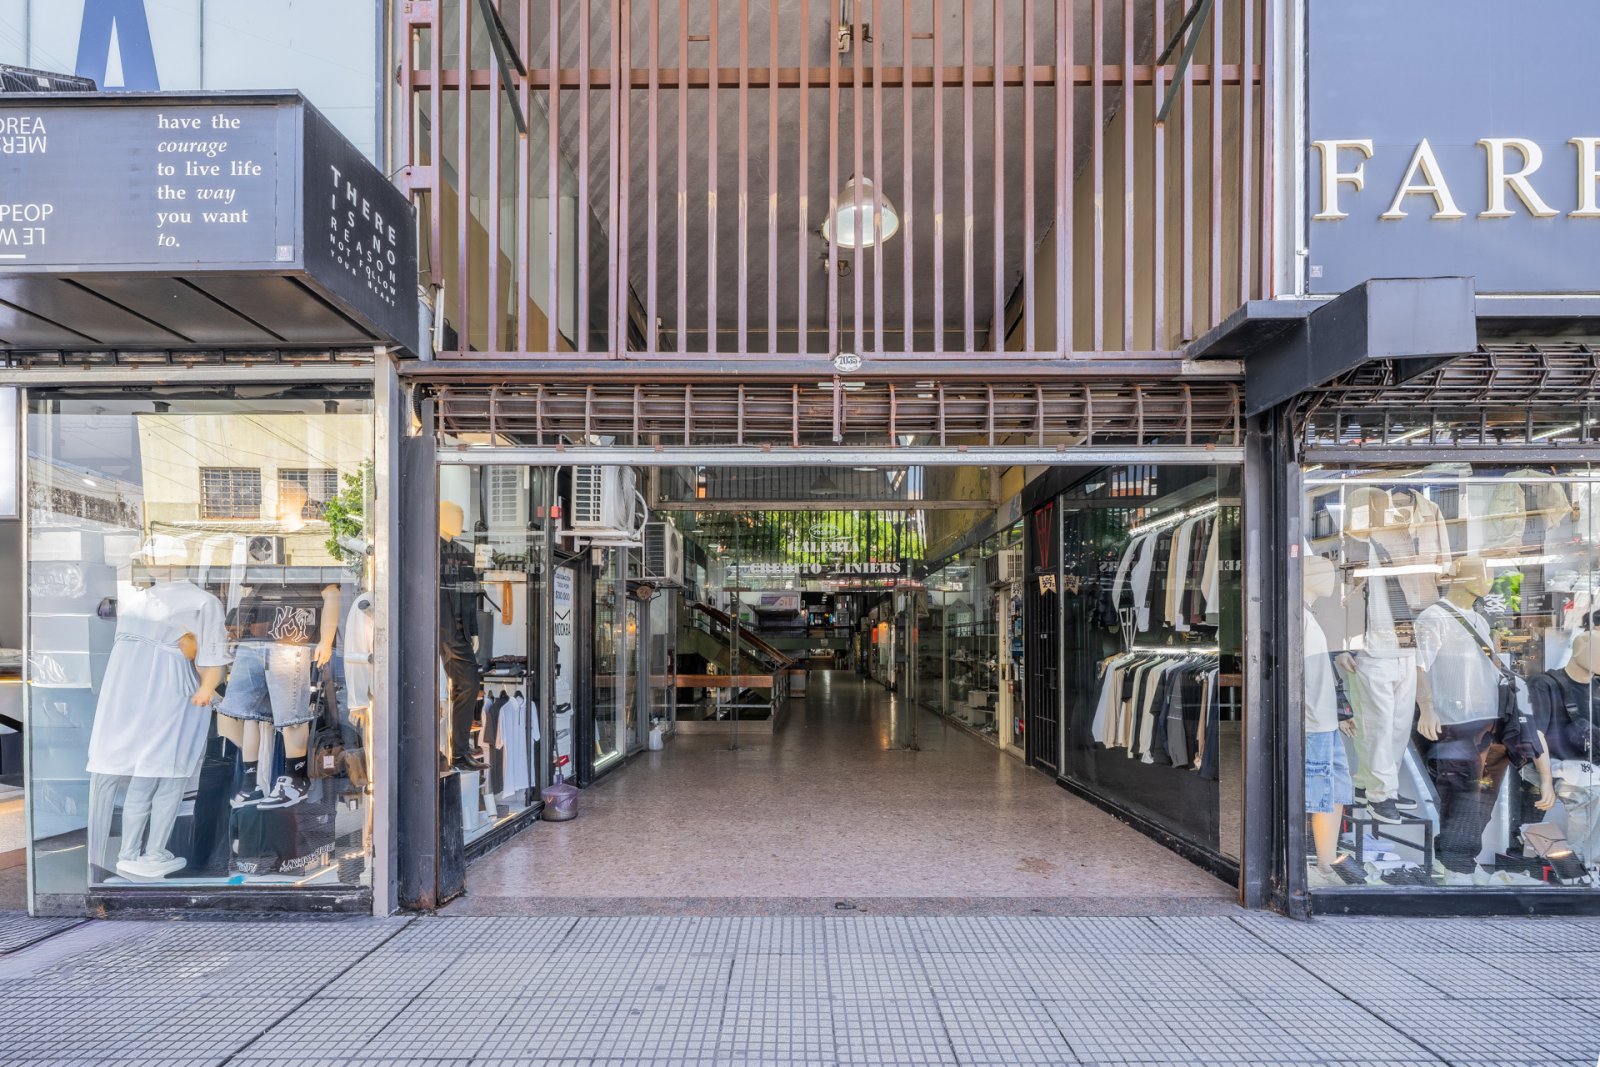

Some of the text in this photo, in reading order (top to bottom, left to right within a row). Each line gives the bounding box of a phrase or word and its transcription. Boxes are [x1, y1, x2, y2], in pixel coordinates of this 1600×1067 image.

[157, 113, 241, 129] have the
[157, 141, 228, 158] courage
[157, 160, 262, 177] to live life
[157, 184, 236, 204] the way
[0, 203, 54, 222] PEOP
[330, 164, 396, 247] THERE
[157, 209, 249, 228] you want
[157, 232, 180, 248] to.
[787, 541, 860, 553] GALERIA
[834, 562, 901, 574] LINIERS
